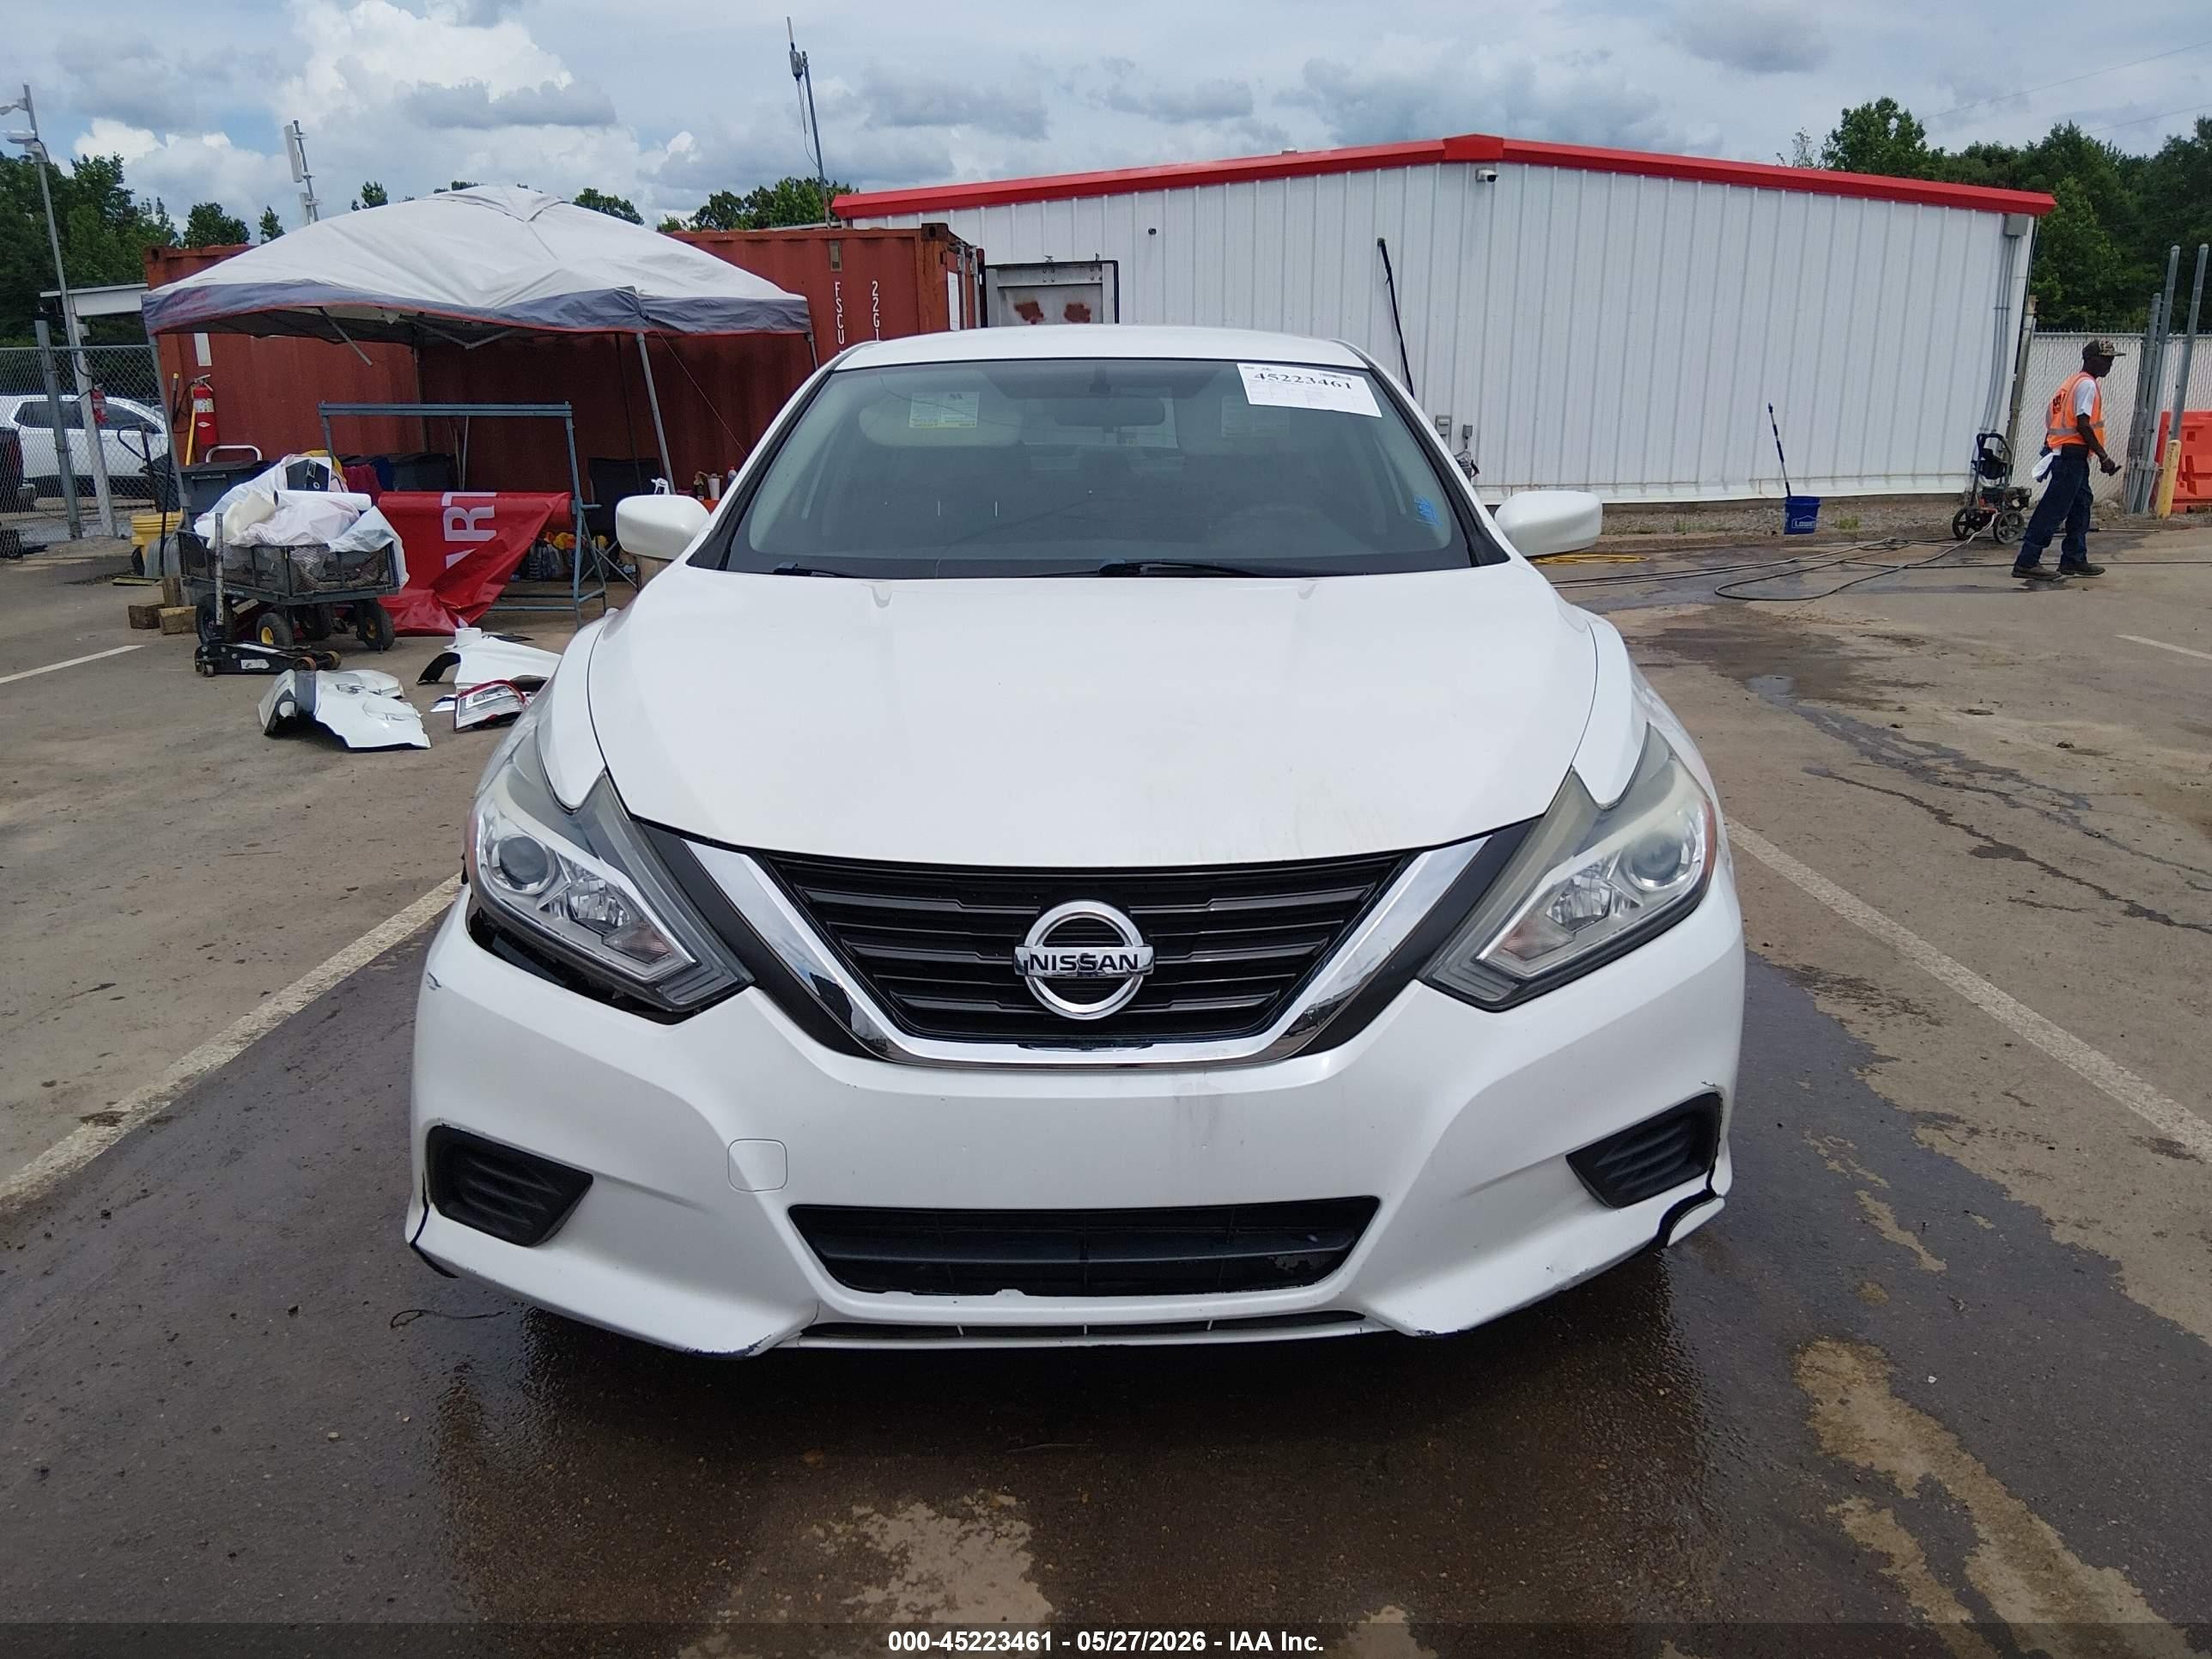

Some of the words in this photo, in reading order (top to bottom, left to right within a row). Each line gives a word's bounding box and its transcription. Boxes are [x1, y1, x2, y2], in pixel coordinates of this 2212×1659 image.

[835, 281, 845, 345] FSCU
[872, 280, 880, 342] 22G1
[1254, 372, 1353, 391] 45223461
[1030, 953, 1139, 971] NISSAN
